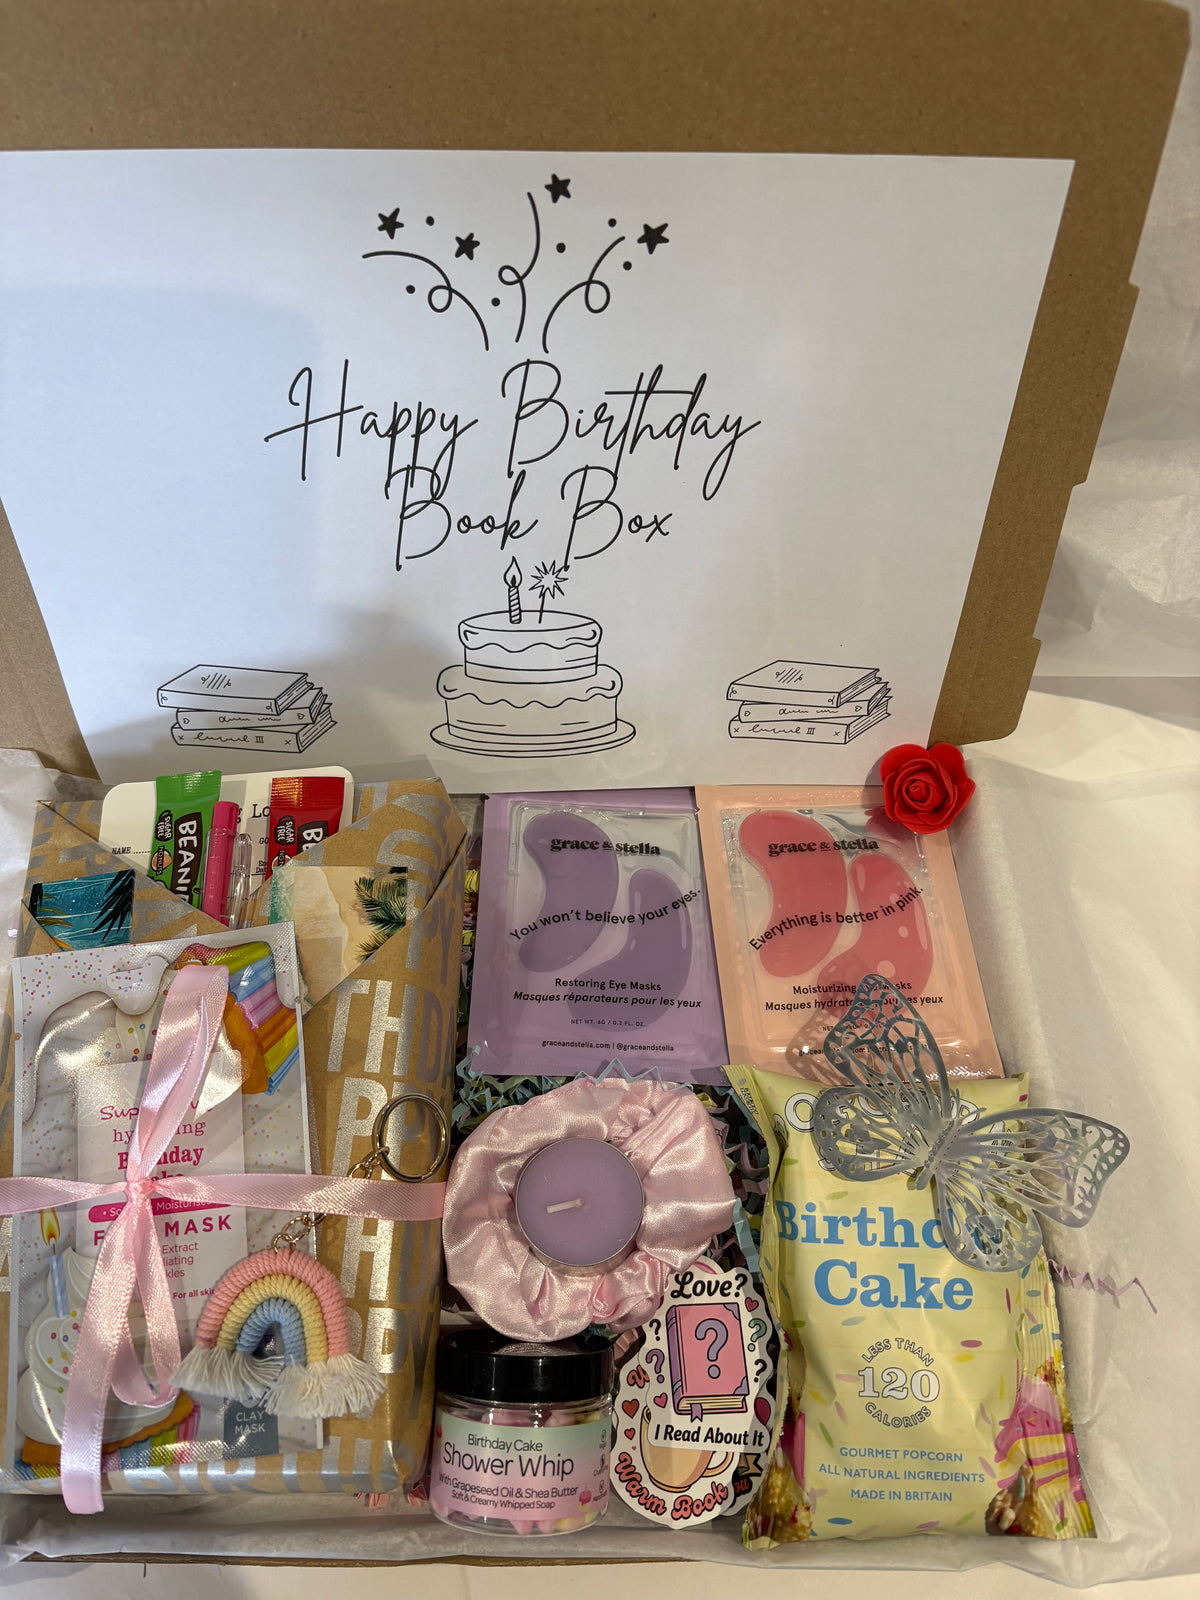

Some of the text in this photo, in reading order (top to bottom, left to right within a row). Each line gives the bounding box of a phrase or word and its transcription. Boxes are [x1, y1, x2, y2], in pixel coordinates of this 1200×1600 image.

[264, 358, 761, 501] Happy Birthday
[385, 464, 673, 571] Book Box
[252, 803, 270, 818] Lo
[157, 821, 165, 838] FREE
[164, 816, 172, 839] SUGAR
[277, 825, 285, 841] FREE
[285, 821, 295, 843] SUGAR
[112, 846, 132, 855] NAME
[550, 837, 661, 856] grace & stella
[768, 838, 879, 857] grace & stella
[509, 888, 702, 941] You won't believe your eyes.
[749, 886, 924, 950] Everything is better in pink.
[554, 978, 662, 992] Restoring Eye Masks
[792, 983, 857, 996] Moisturizing
[513, 990, 702, 1009] Masques réparateurs pour les yeux
[765, 1000, 812, 1013] Masques
[814, 997, 853, 1011] hydrat
[920, 995, 944, 1006] yeux
[542, 1039, 611, 1050] graceandstella.com
[616, 1042, 675, 1052] @graceandstella
[165, 1214, 232, 1237] MASK
[776, 1200, 956, 1251] Birthd
[161, 1242, 199, 1255] Extract
[670, 1267, 748, 1299] Love?
[814, 1258, 974, 1311] Cake
[172, 1291, 187, 1300] For
[188, 1288, 198, 1298] all
[861, 1337, 934, 1367] LESS THAN
[857, 1366, 941, 1403] 120
[235, 1410, 265, 1422] CLAY
[865, 1401, 932, 1428] CALORIES
[234, 1422, 266, 1435] MASK
[654, 1424, 764, 1447] I Read About It
[467, 1433, 543, 1453] Birthday Cake
[443, 1441, 574, 1482] Shower Whip
[839, 1446, 963, 1463] GOURMET POPCORN
[818, 1463, 985, 1484] ALL NATURAL INGREDIENTS
[438, 1471, 452, 1487] With
[452, 1477, 499, 1497] Grapeseed
[500, 1486, 514, 1498] Oil
[515, 1487, 524, 1499] &
[525, 1487, 549, 1499] Shea
[551, 1486, 579, 1498] Butter
[614, 1451, 729, 1521] Warm Book
[850, 1488, 953, 1502] MADE IN BRITAIN
[451, 1489, 556, 1511] Soft & Creamy Whipped Soap
